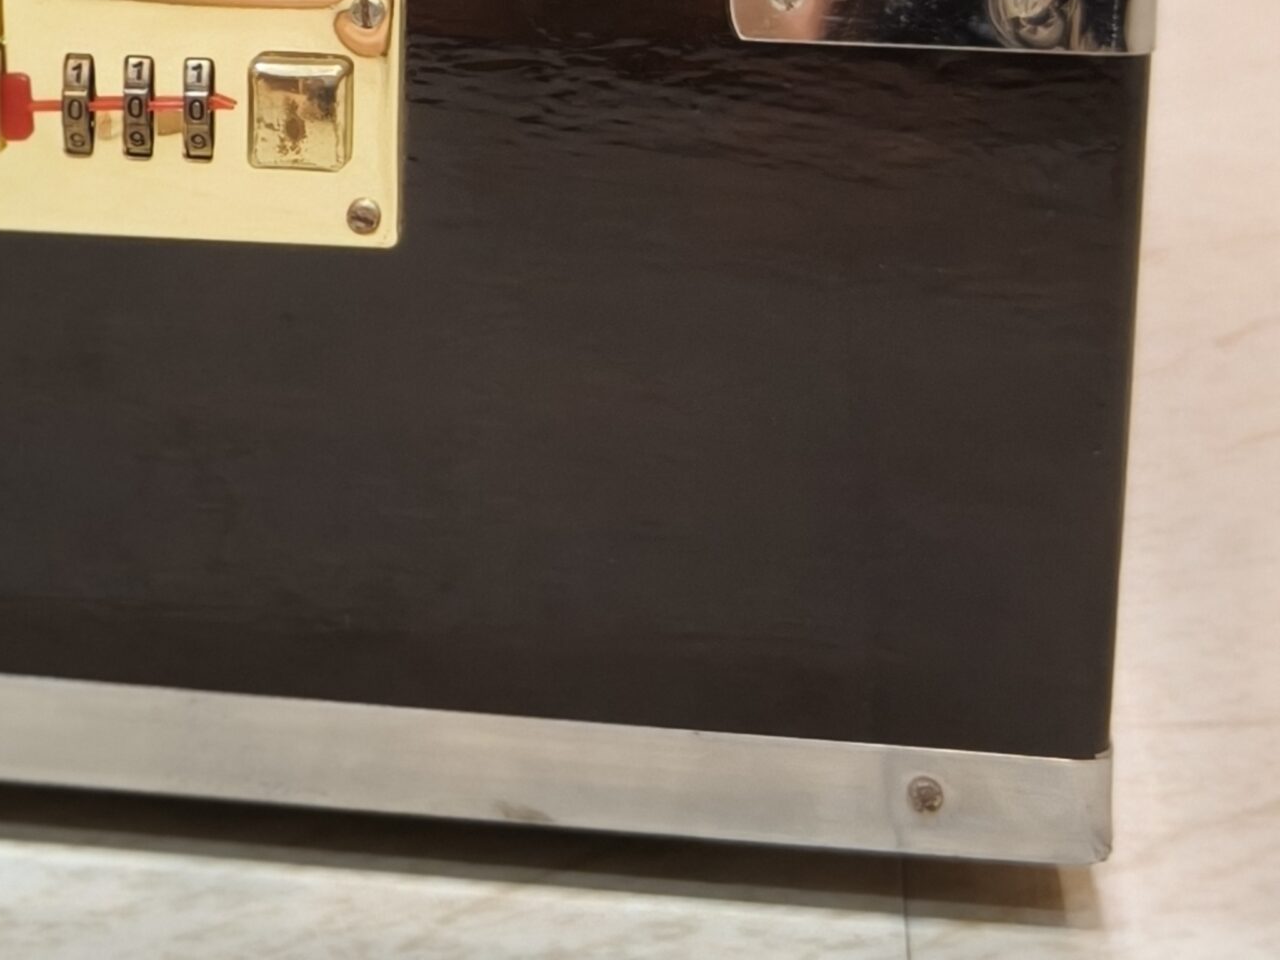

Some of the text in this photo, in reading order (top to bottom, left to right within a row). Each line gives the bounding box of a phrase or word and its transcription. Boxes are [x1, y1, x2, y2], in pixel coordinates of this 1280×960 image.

[71, 60, 203, 84] 1 1 1
[67, 96, 205, 121] 0 0 0
[129, 130, 145, 147] 9
[190, 133, 207, 149] 9
